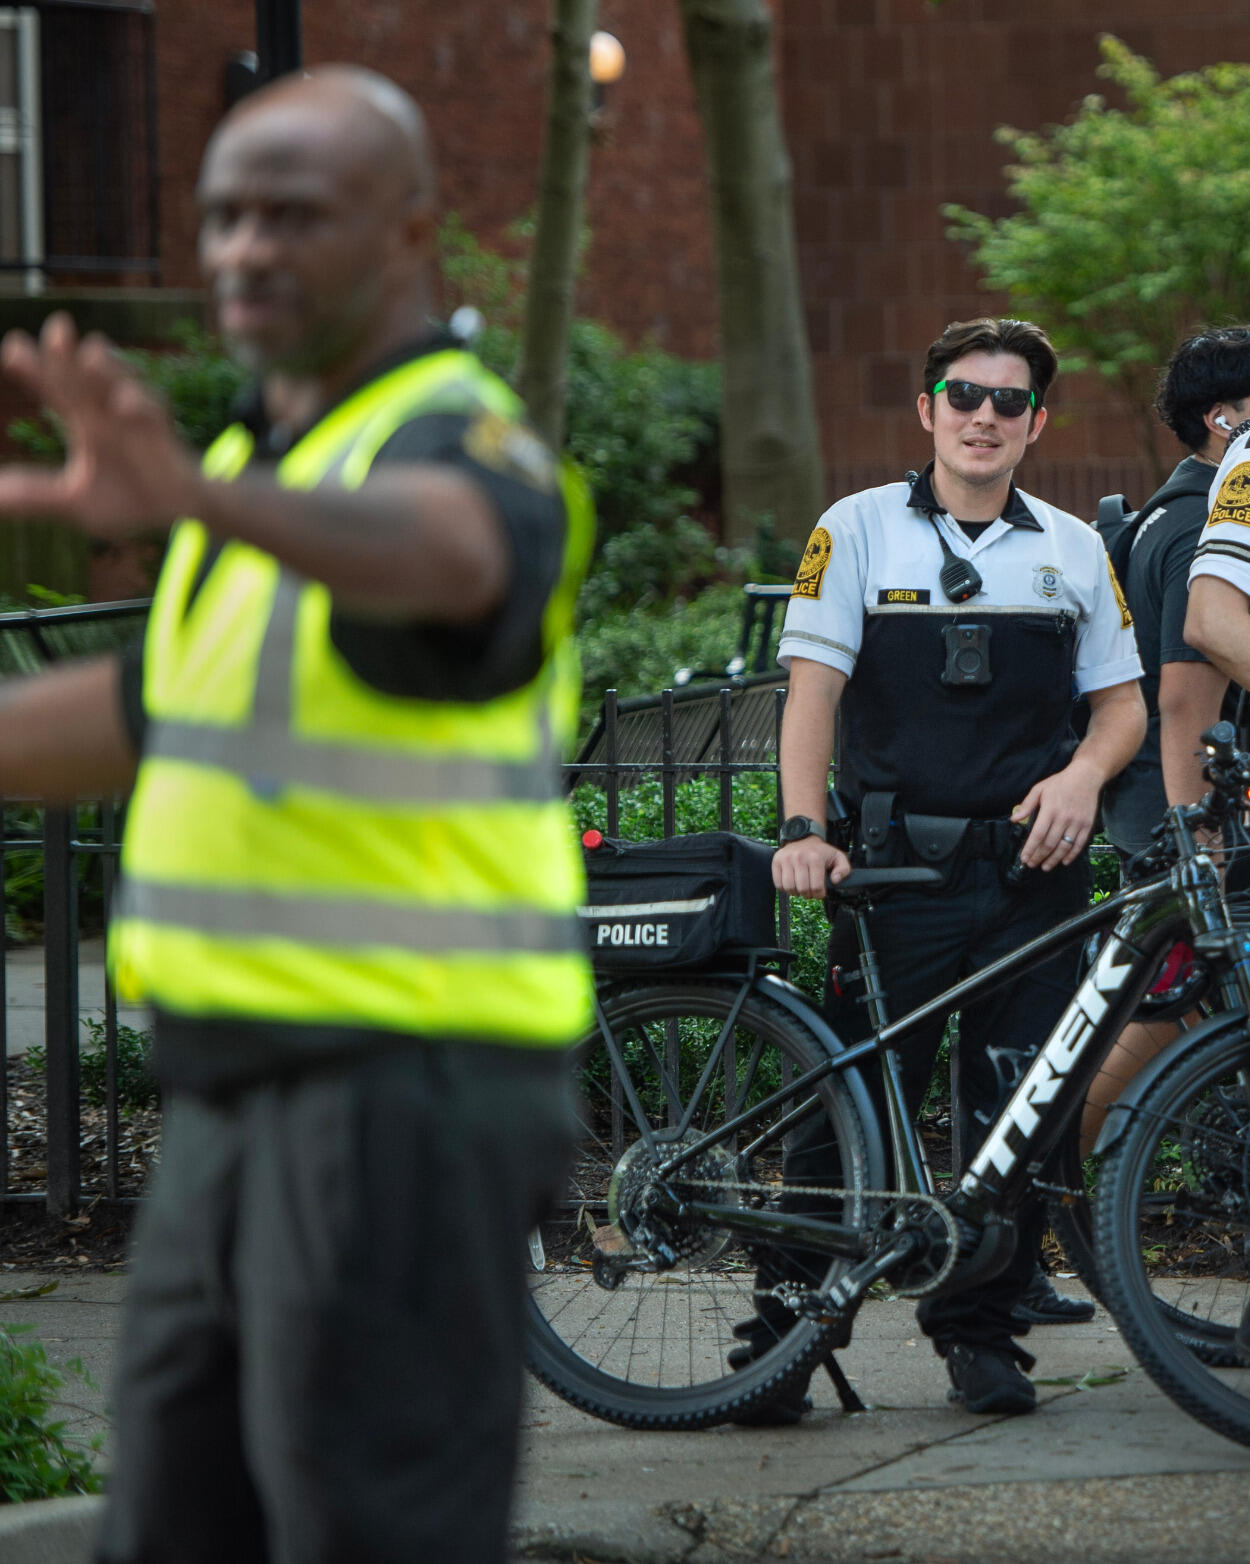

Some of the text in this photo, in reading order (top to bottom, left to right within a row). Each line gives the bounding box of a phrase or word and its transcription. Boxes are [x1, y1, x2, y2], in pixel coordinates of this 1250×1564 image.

[794, 582, 817, 594] LICE
[887, 590, 917, 601] GREEN
[597, 923, 669, 945] POLICE
[970, 935, 1133, 1177] TREK
